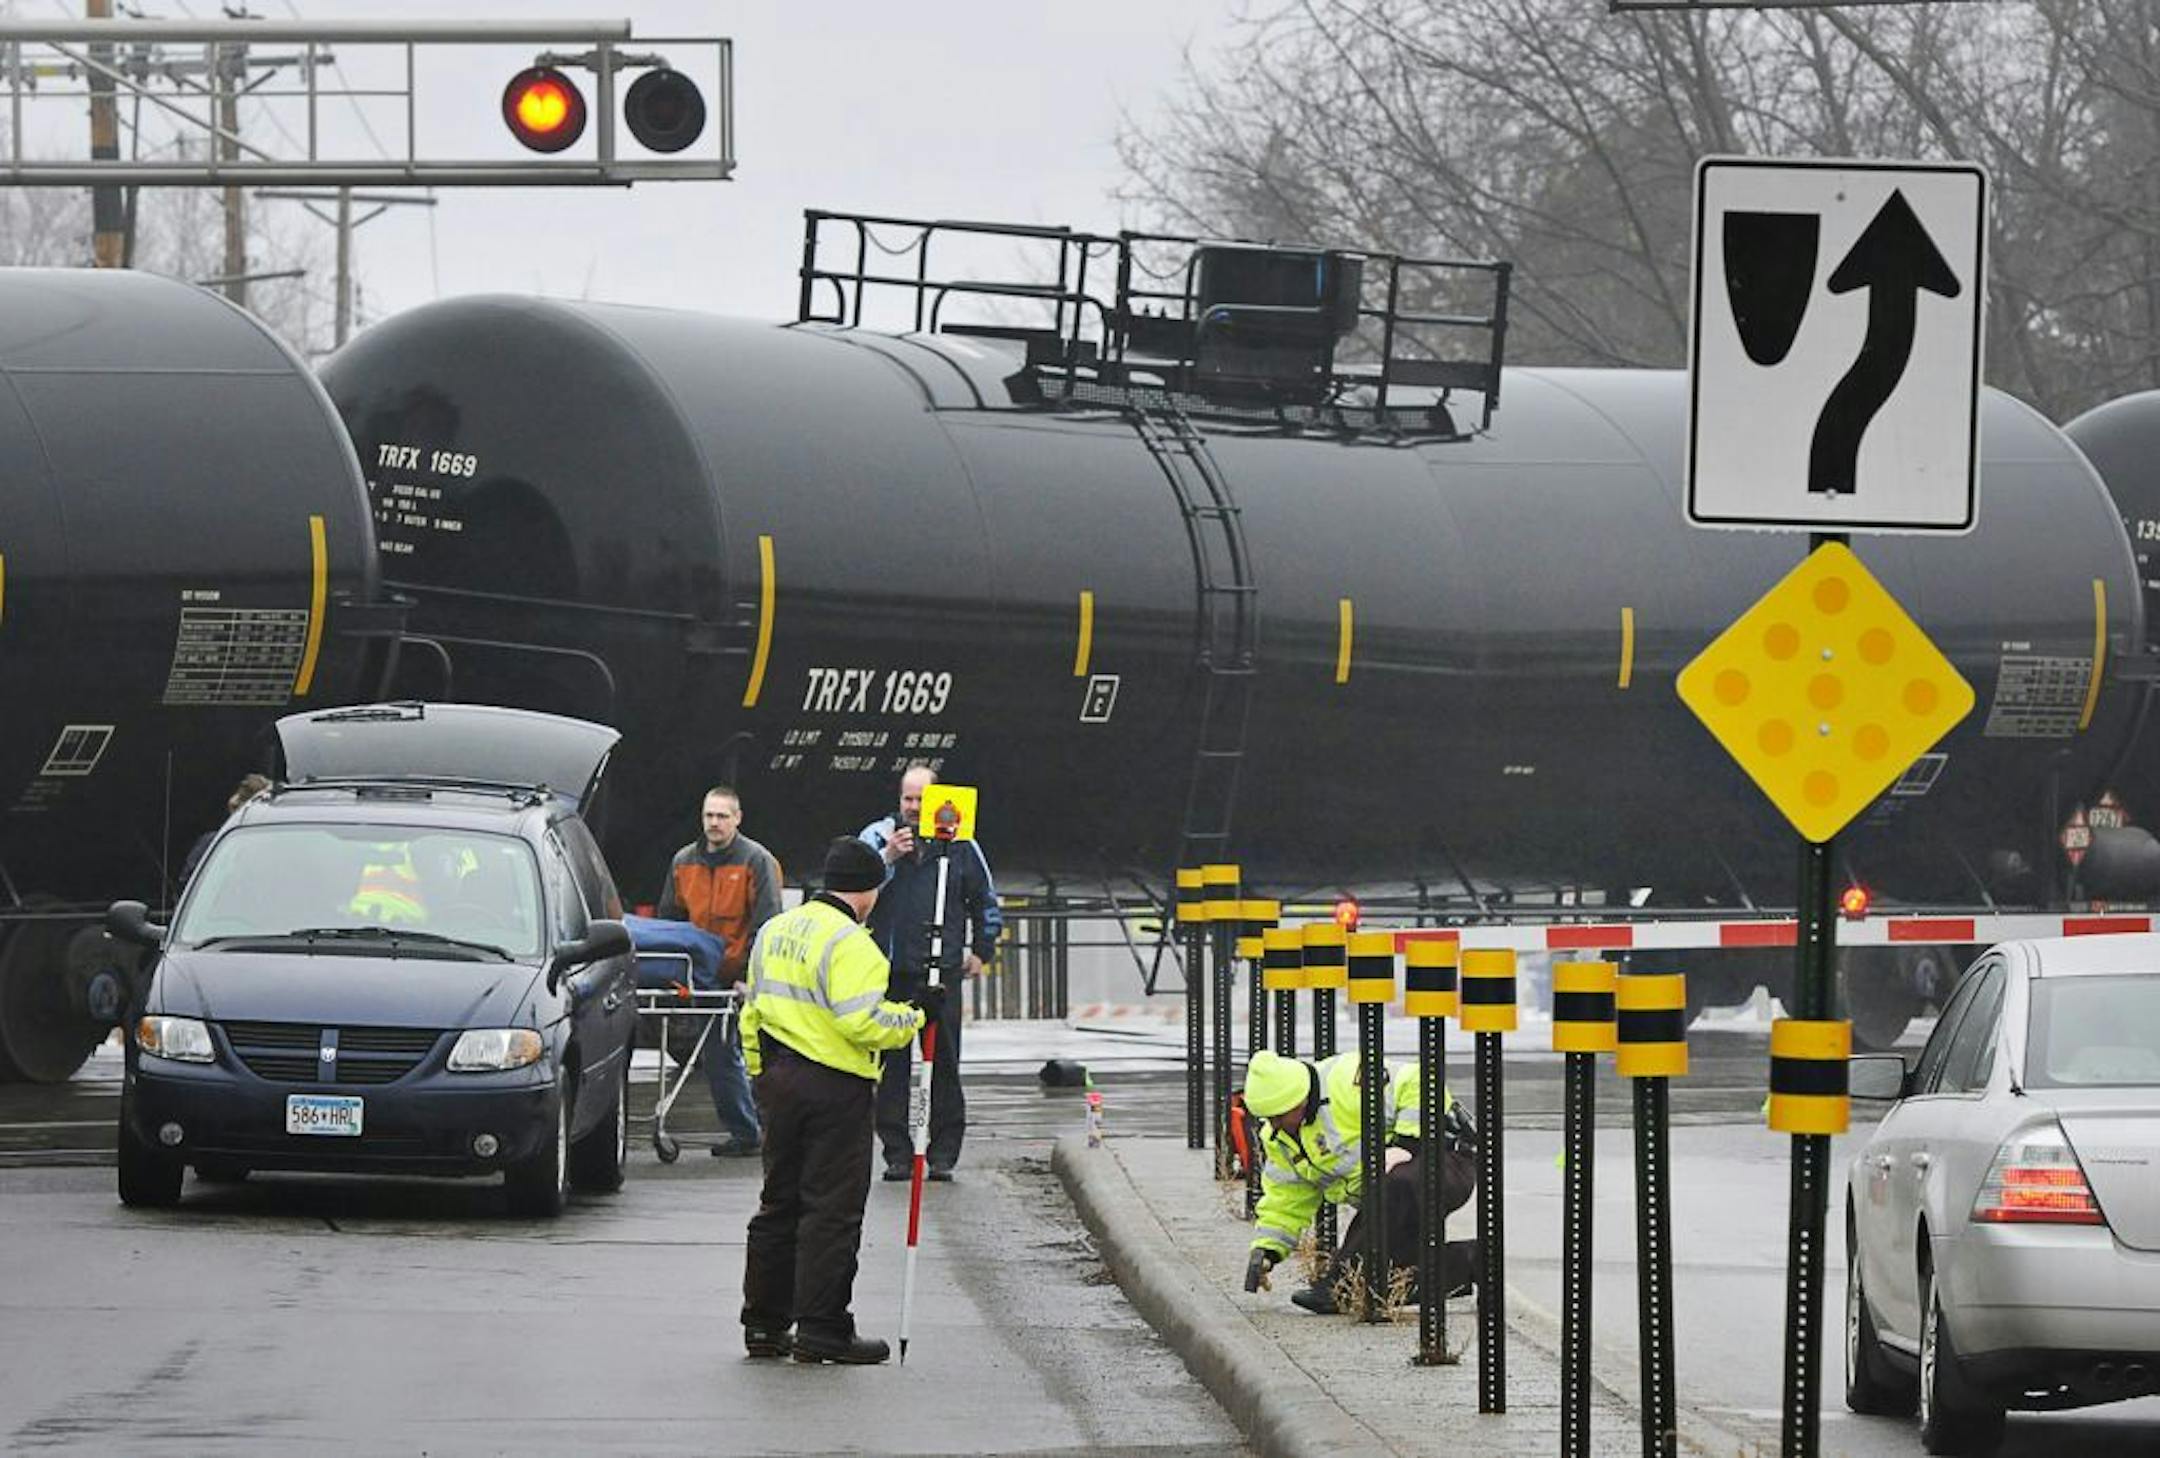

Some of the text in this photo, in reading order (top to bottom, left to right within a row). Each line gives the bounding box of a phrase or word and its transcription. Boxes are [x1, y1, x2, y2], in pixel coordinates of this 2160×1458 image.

[378, 444, 478, 477] TRFX 1669
[802, 667, 953, 715] TRFX 1669
